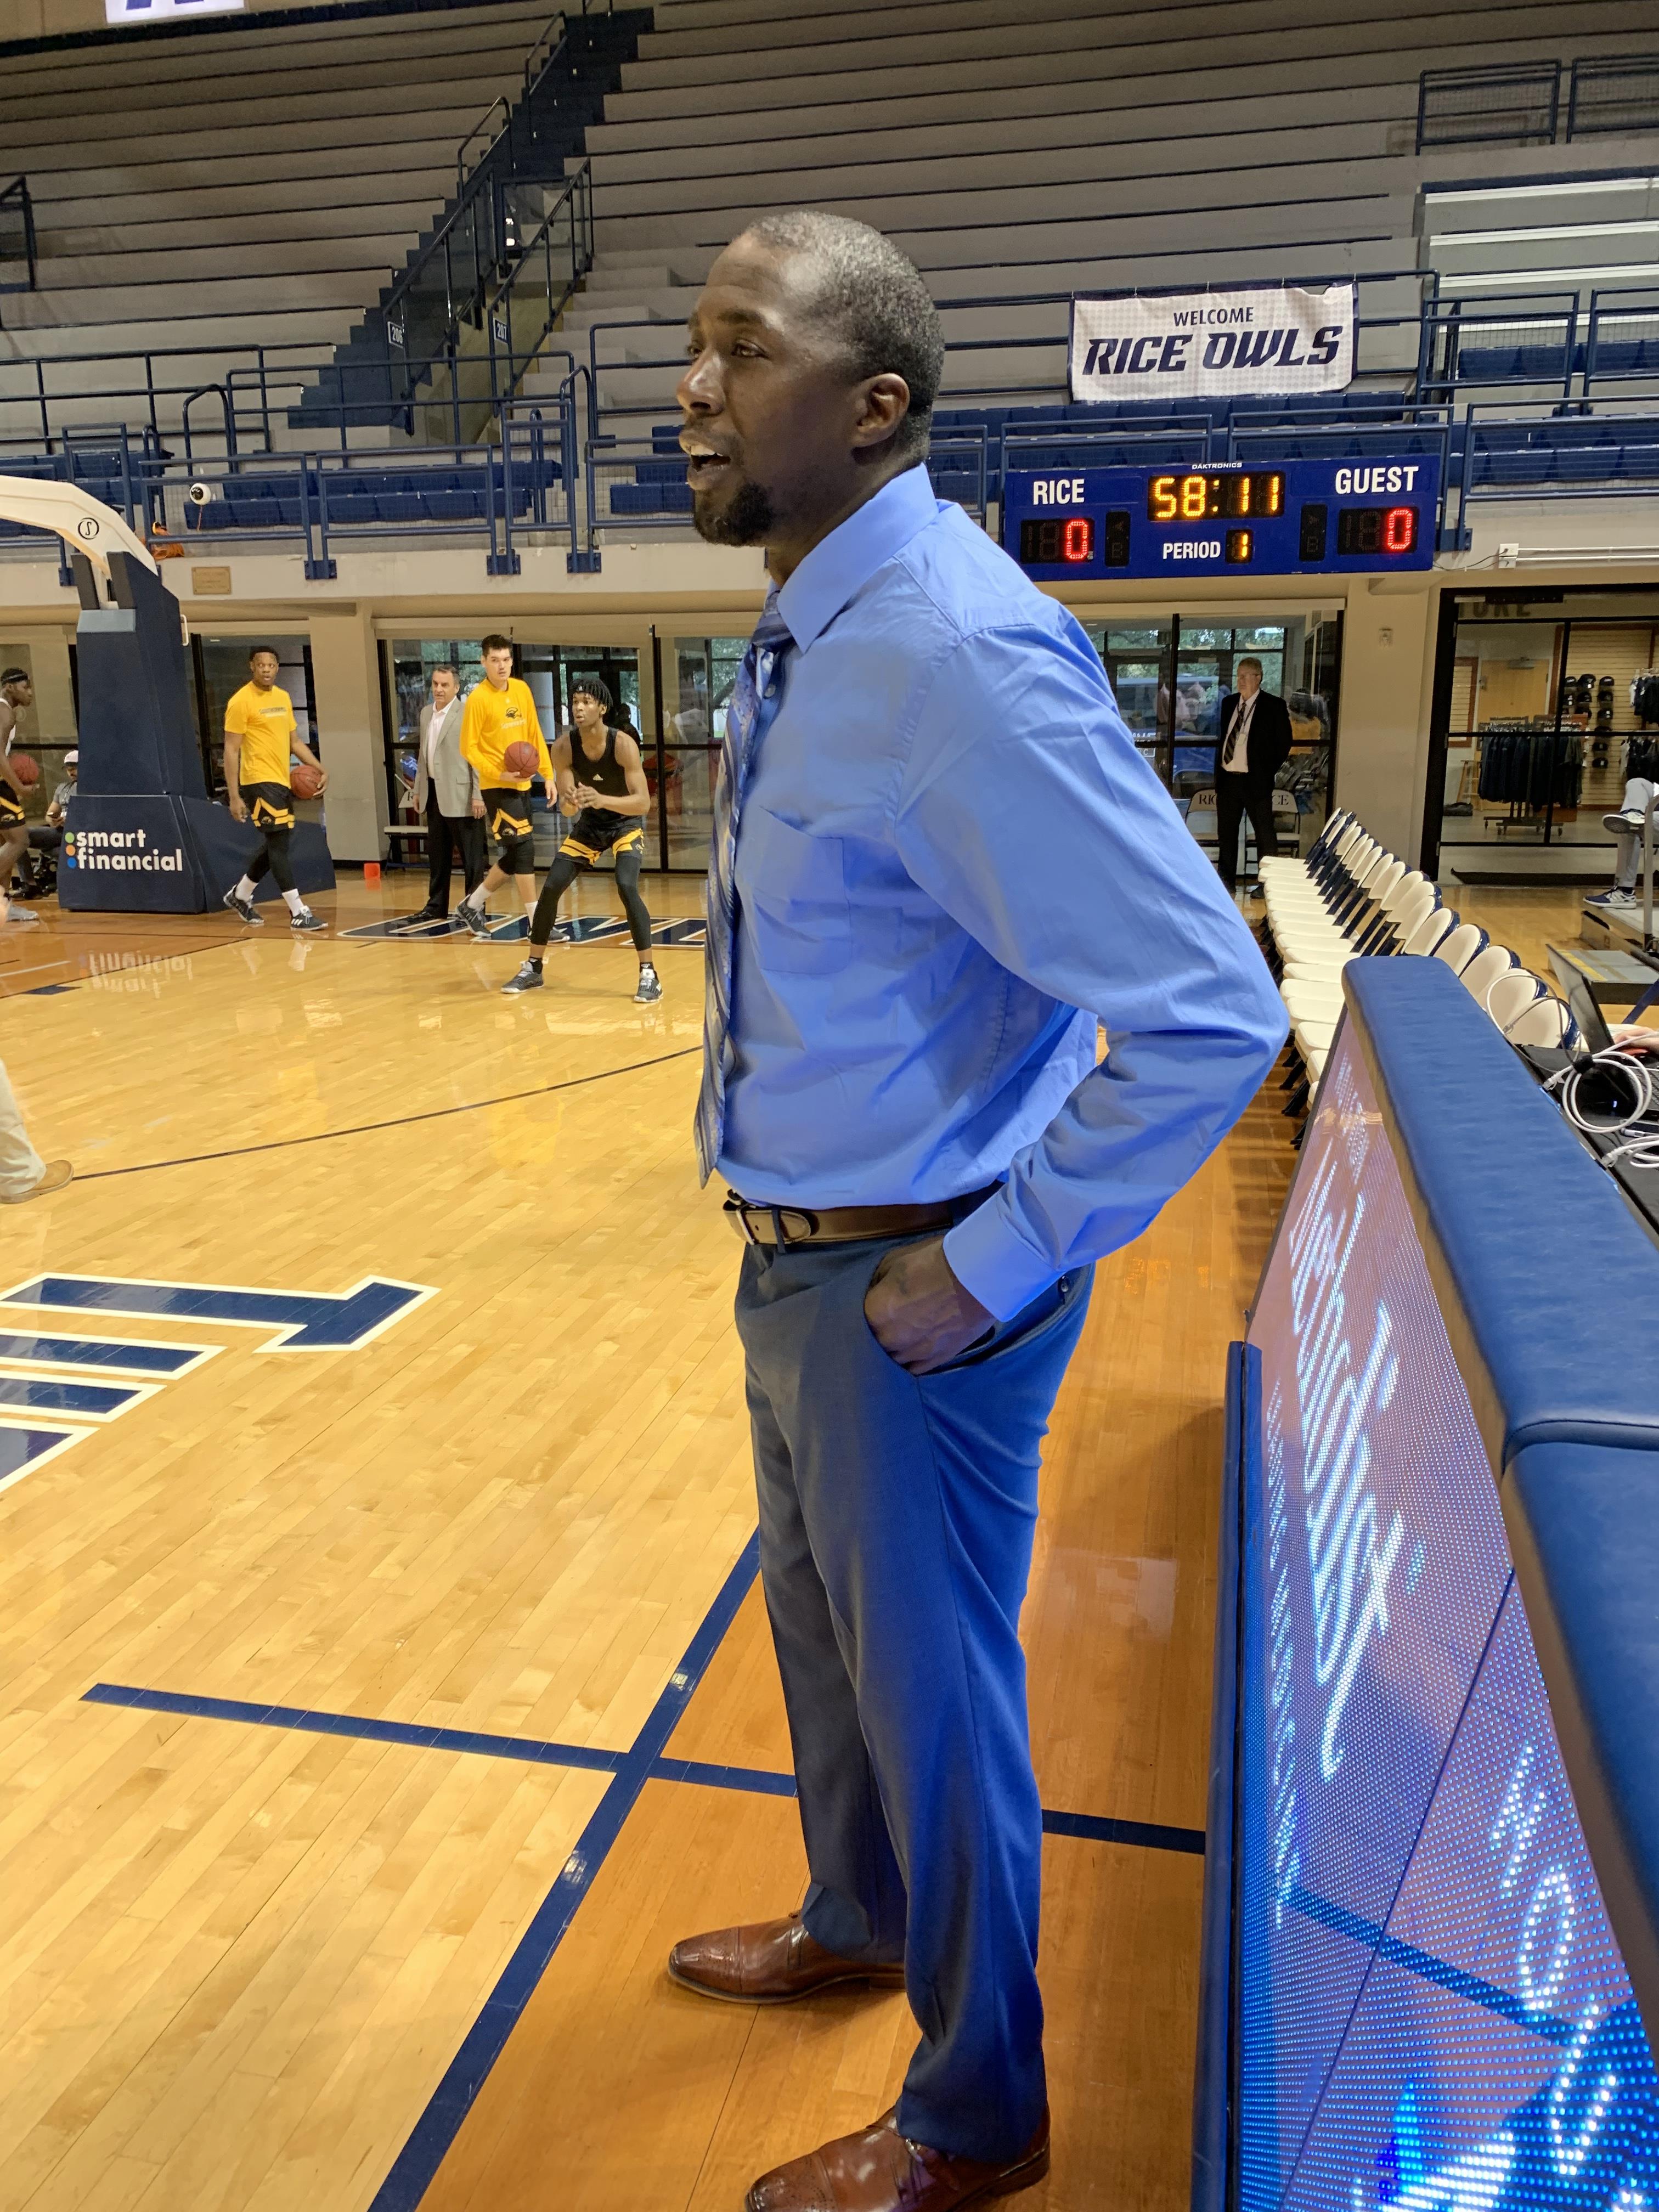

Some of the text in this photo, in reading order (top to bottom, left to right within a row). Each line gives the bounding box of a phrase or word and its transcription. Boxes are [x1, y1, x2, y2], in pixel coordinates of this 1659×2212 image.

[1173, 307, 1254, 326] WELCOME
[498, 323, 506, 340] 207
[1082, 326, 1344, 375] RICE OWLS
[1033, 478, 1085, 505] RICE
[1335, 466, 1419, 494] GUEST
[1155, 476, 1279, 517] 58:11
[1066, 520, 1089, 560] 0
[1387, 509, 1413, 550] 0
[1163, 541, 1221, 559] PERIOD
[1241, 533, 1249, 557] 1
[76, 829, 146, 848] smart
[77, 847, 183, 871] financial
